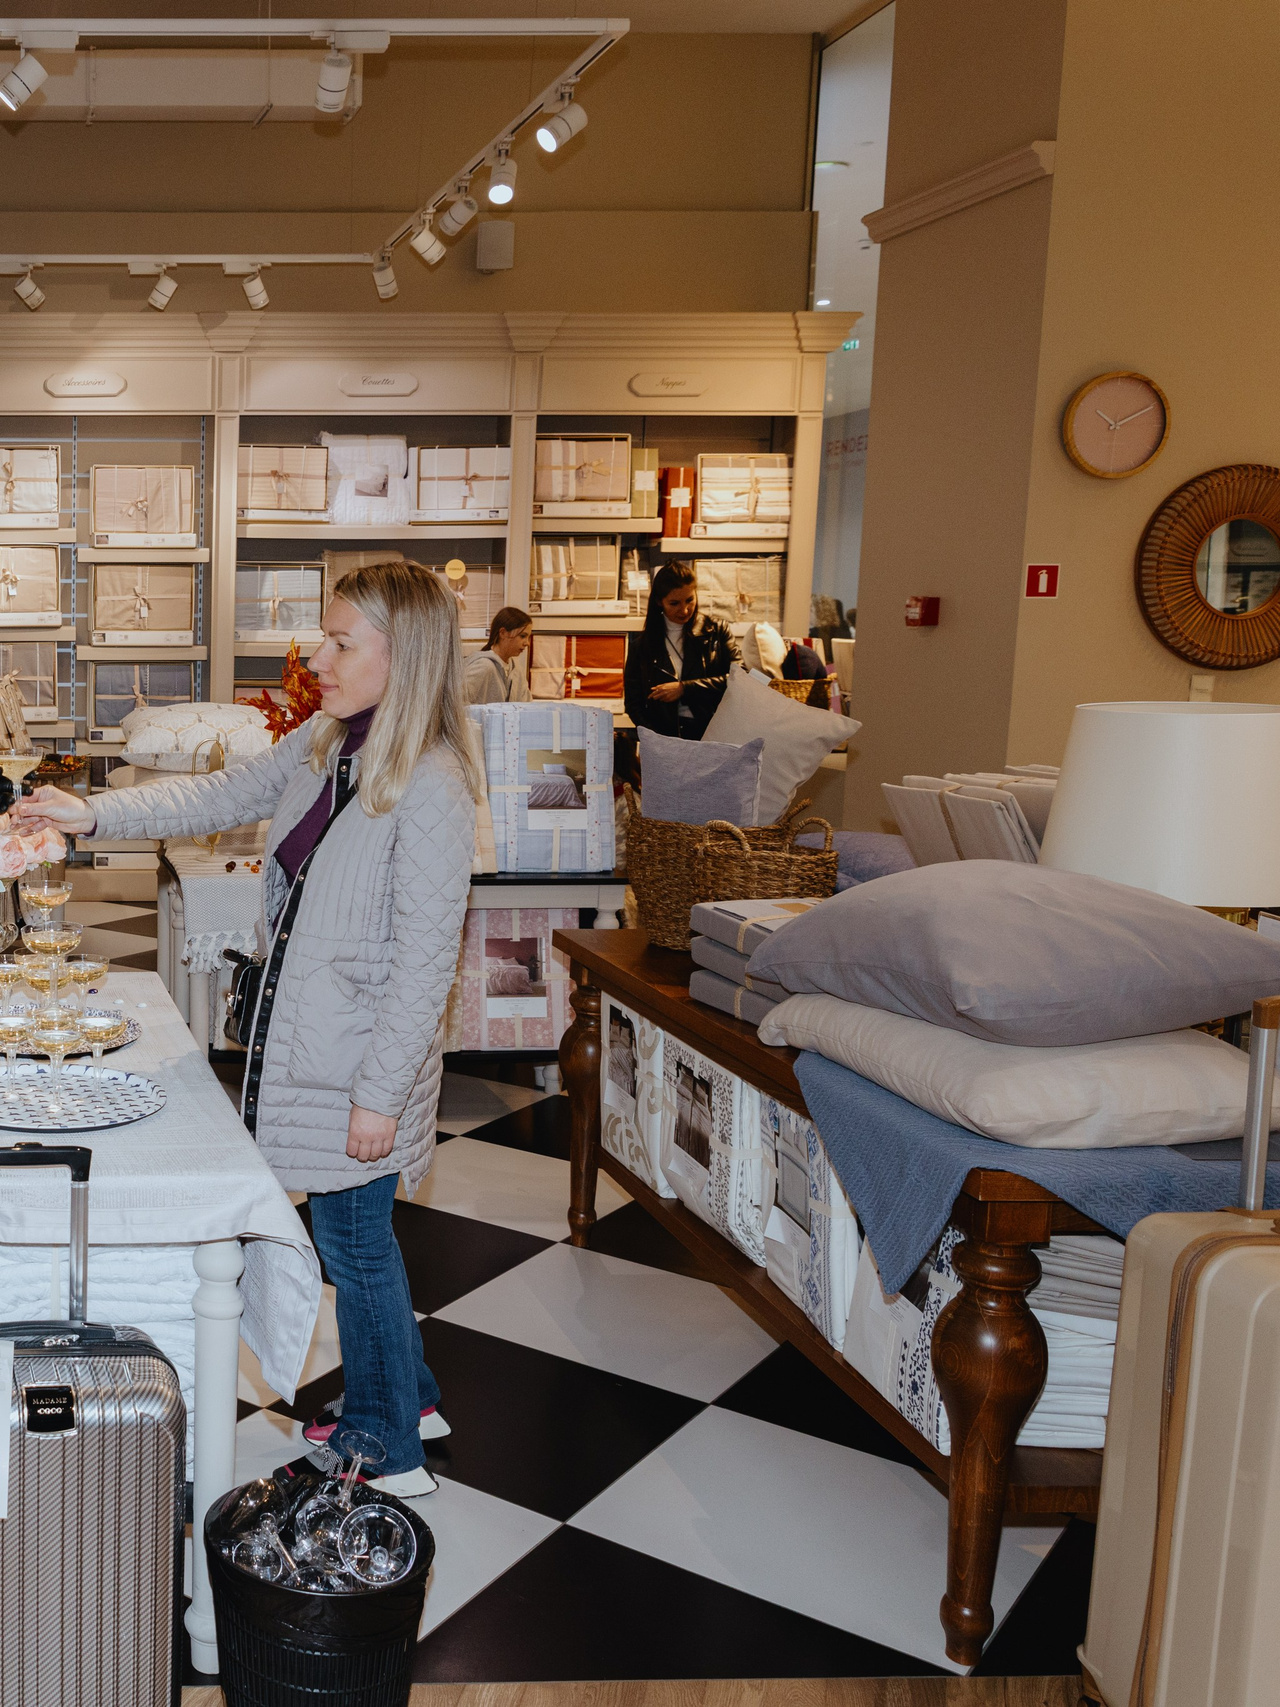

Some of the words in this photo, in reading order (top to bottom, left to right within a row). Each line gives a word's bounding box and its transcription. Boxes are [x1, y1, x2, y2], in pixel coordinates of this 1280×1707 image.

[62, 377, 107, 387] Accessoires
[361, 375, 395, 386] Couettes
[32, 1397, 68, 1405] MADAME
[38, 1407, 63, 1415] COCO
